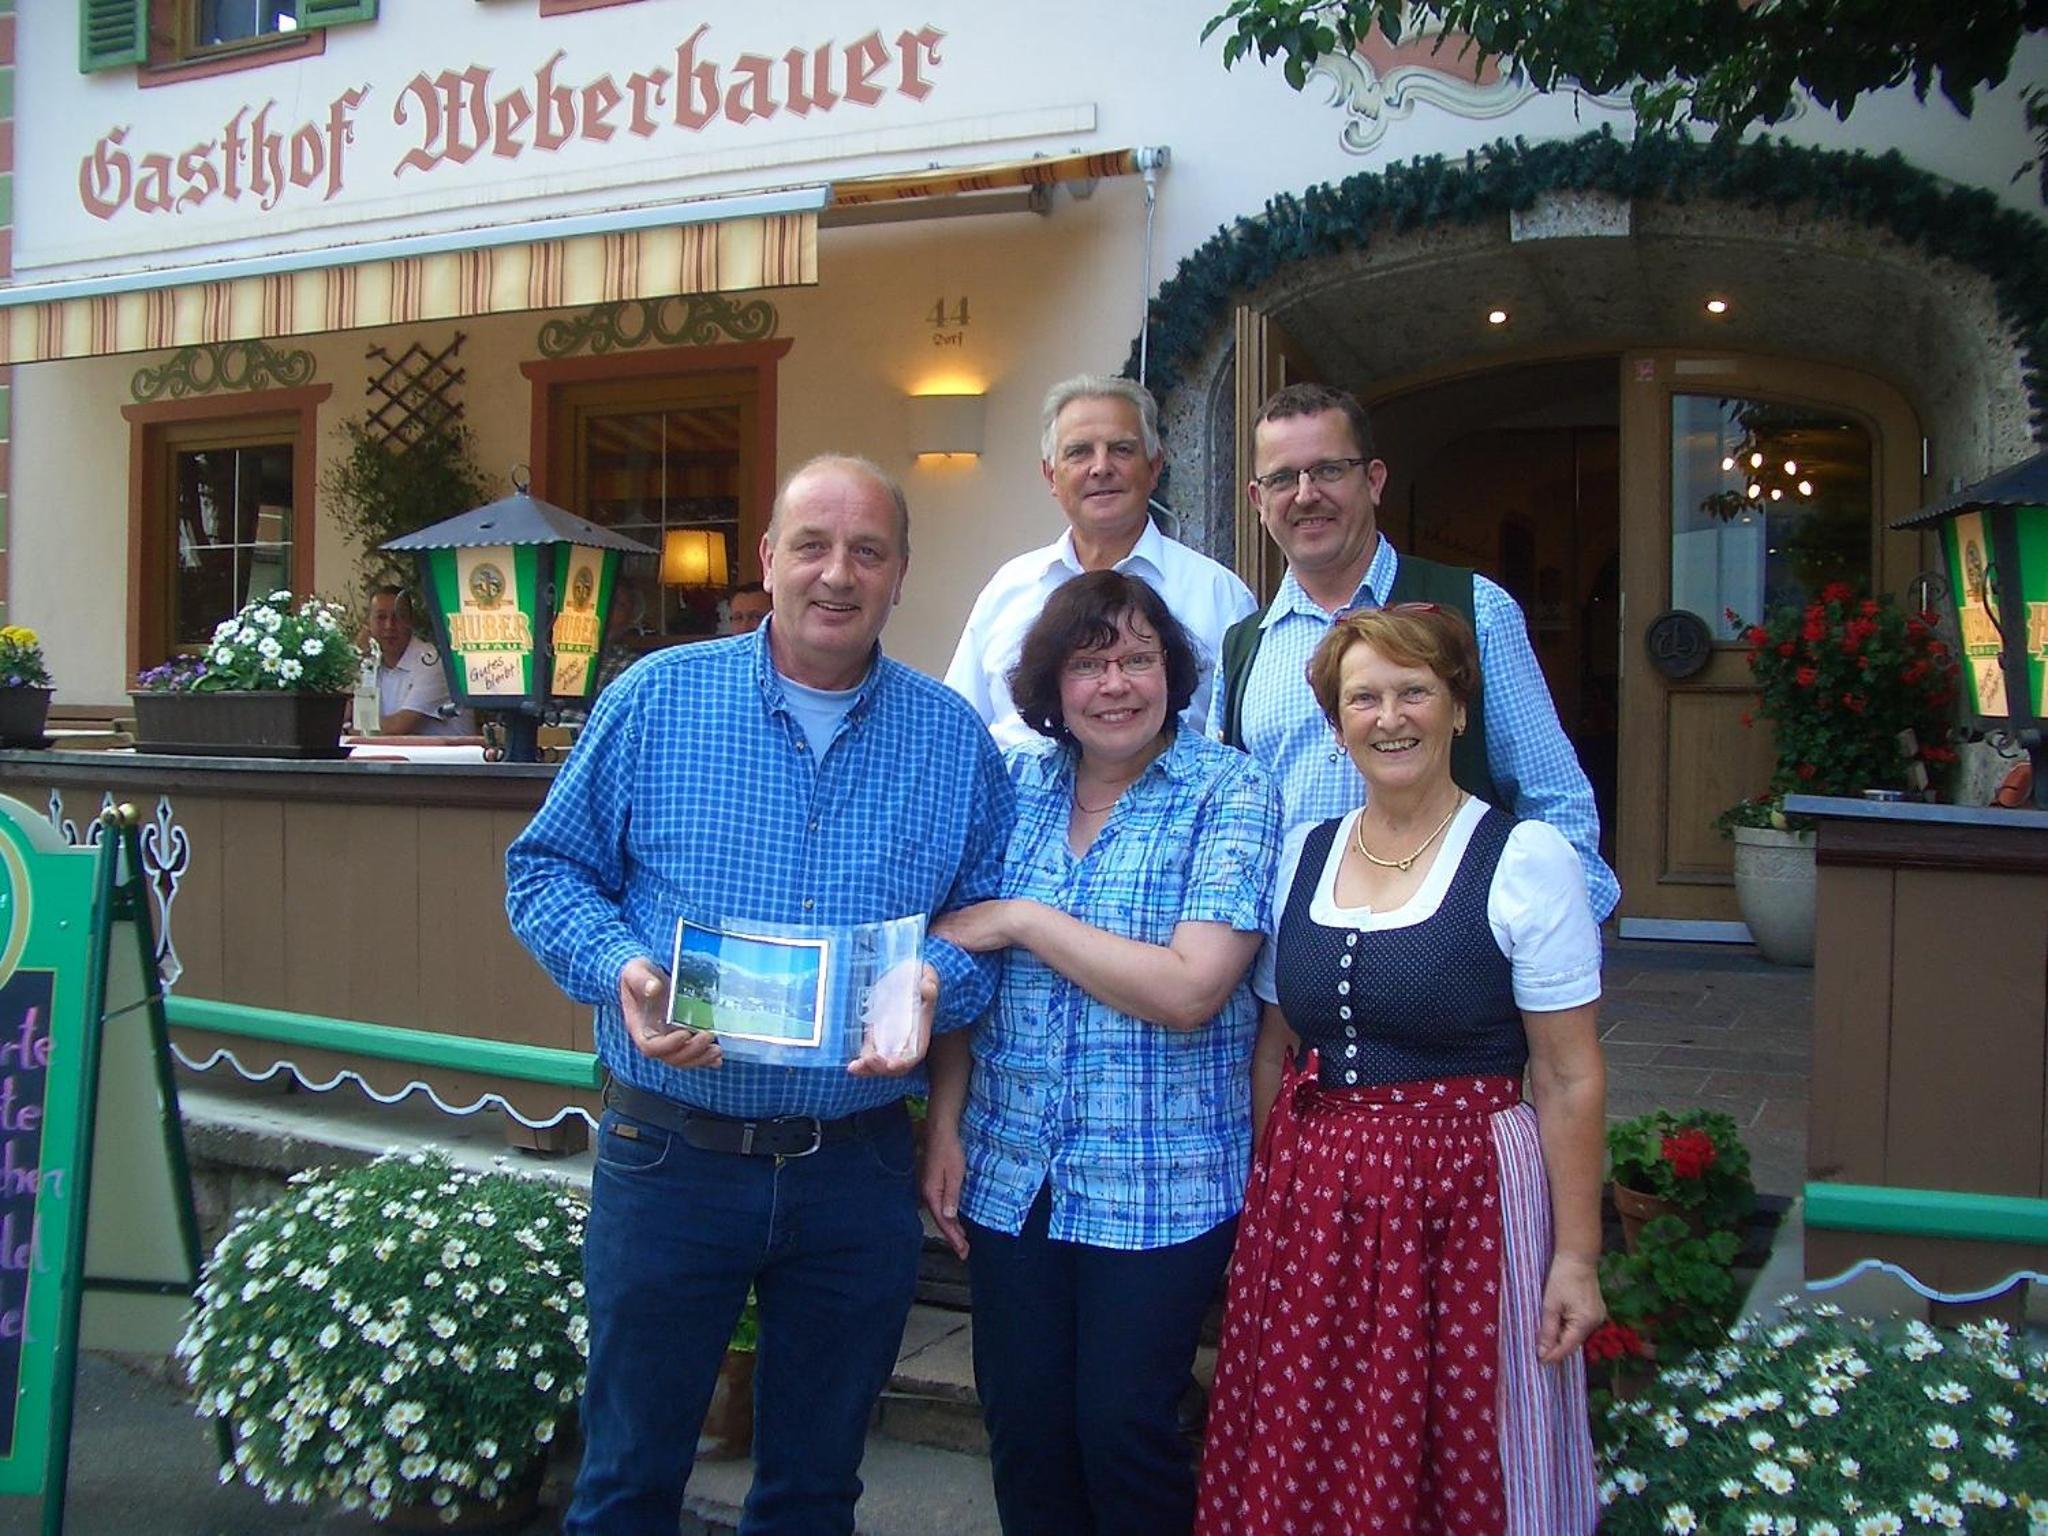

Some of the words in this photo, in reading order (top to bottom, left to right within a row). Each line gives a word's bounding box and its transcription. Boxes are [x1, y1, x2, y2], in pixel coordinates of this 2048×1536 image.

[79, 84, 373, 220] Gasthof
[393, 23, 945, 178] Weberbauer
[925, 296, 971, 327] 44
[450, 612, 532, 648] HUBER
[469, 656, 505, 682] Gutes
